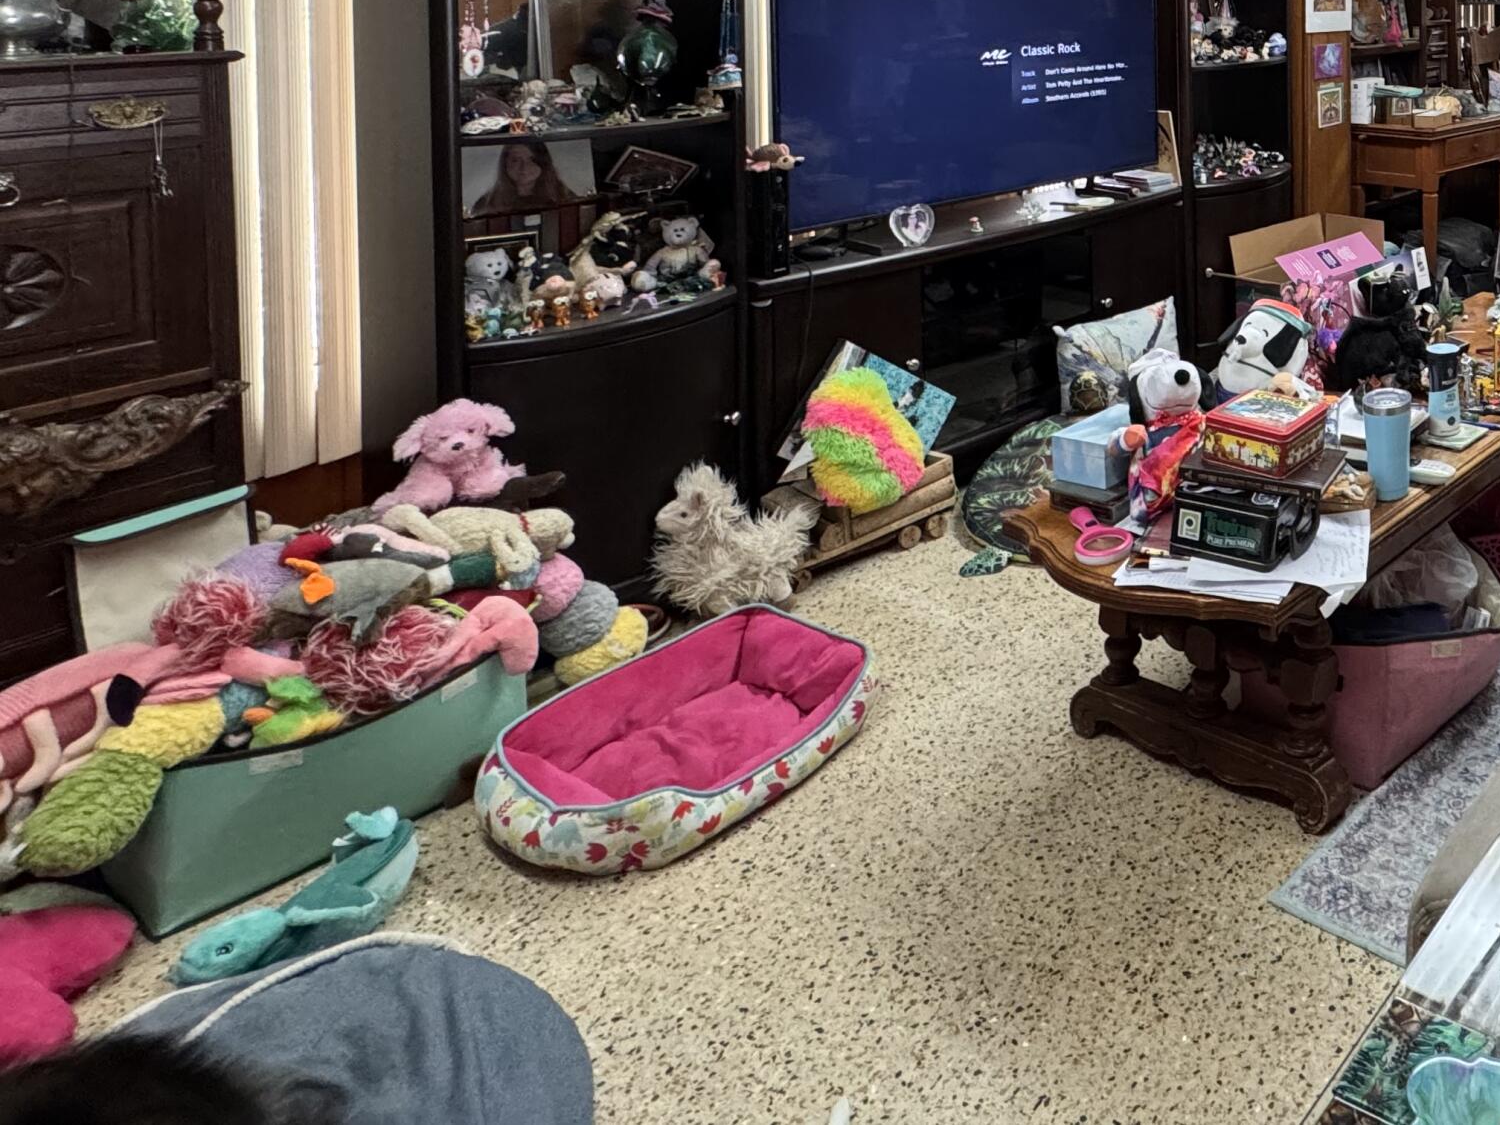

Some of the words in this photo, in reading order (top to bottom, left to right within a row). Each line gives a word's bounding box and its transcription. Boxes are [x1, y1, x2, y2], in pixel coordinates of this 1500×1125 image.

[1021, 44, 1055, 56] Classic
[1058, 43, 1081, 54] Rock
[1057, 80, 1071, 88] Petty
[1224, 537, 1256, 549] PREMIUM
